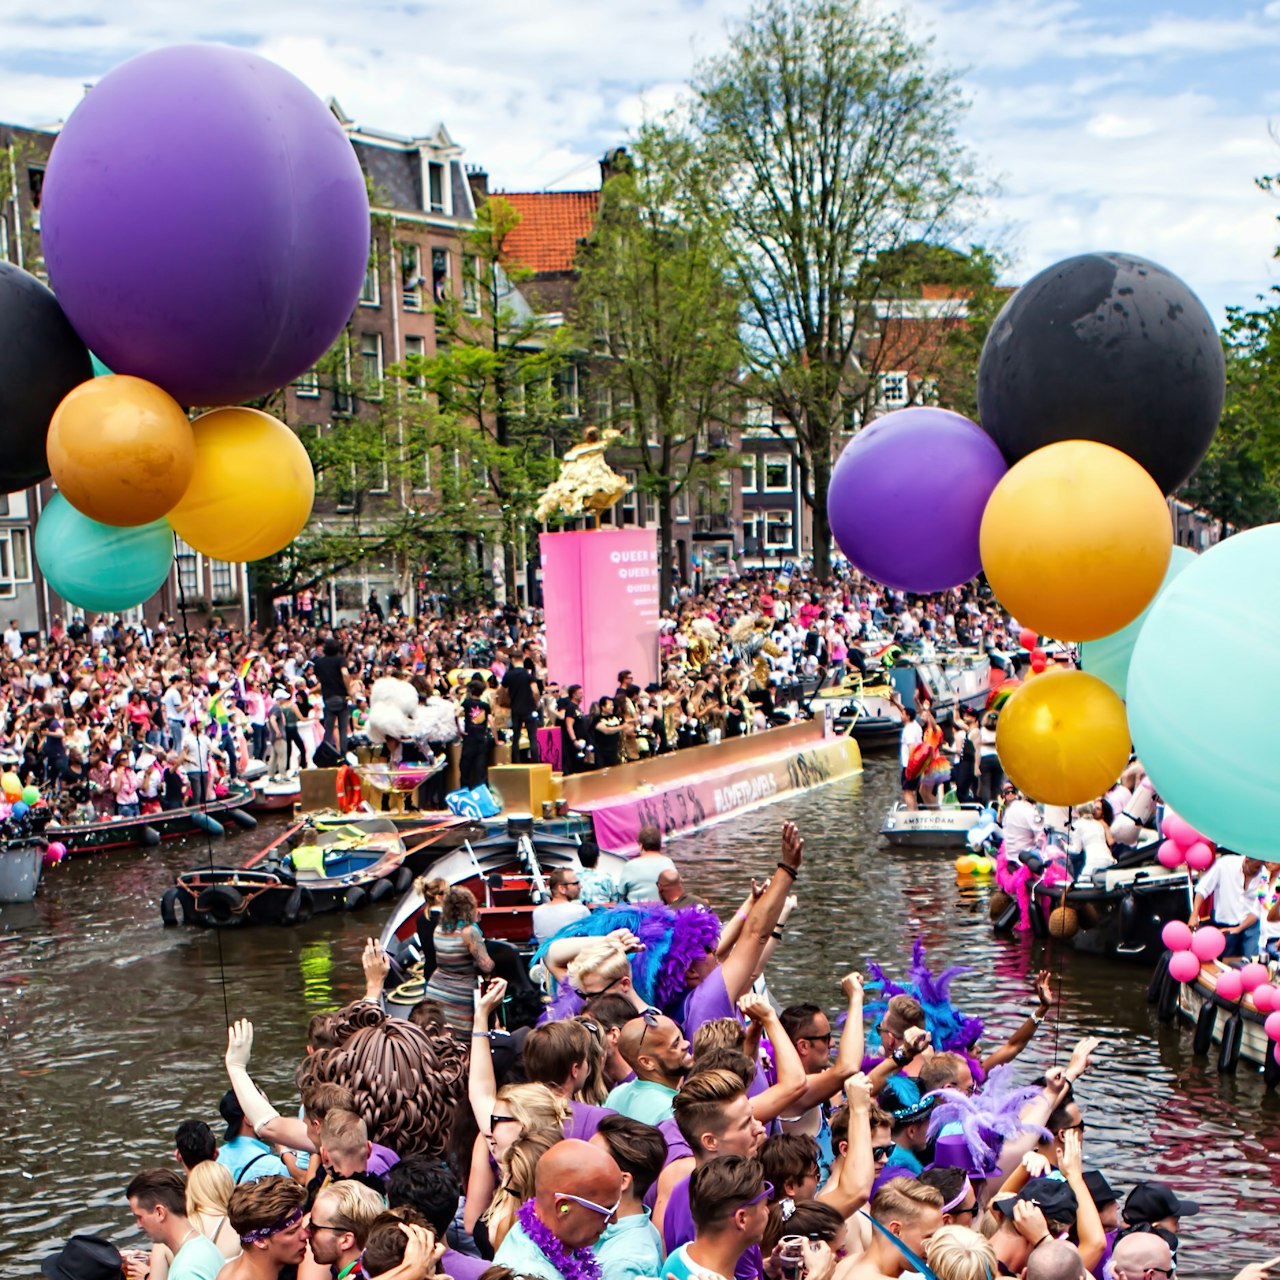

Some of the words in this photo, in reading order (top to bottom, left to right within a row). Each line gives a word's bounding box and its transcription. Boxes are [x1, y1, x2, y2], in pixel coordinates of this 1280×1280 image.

[610, 551, 648, 563] QUEER
[714, 773, 777, 813] #LOVETRAVELS
[904, 817, 955, 825] AMSTERDAM
